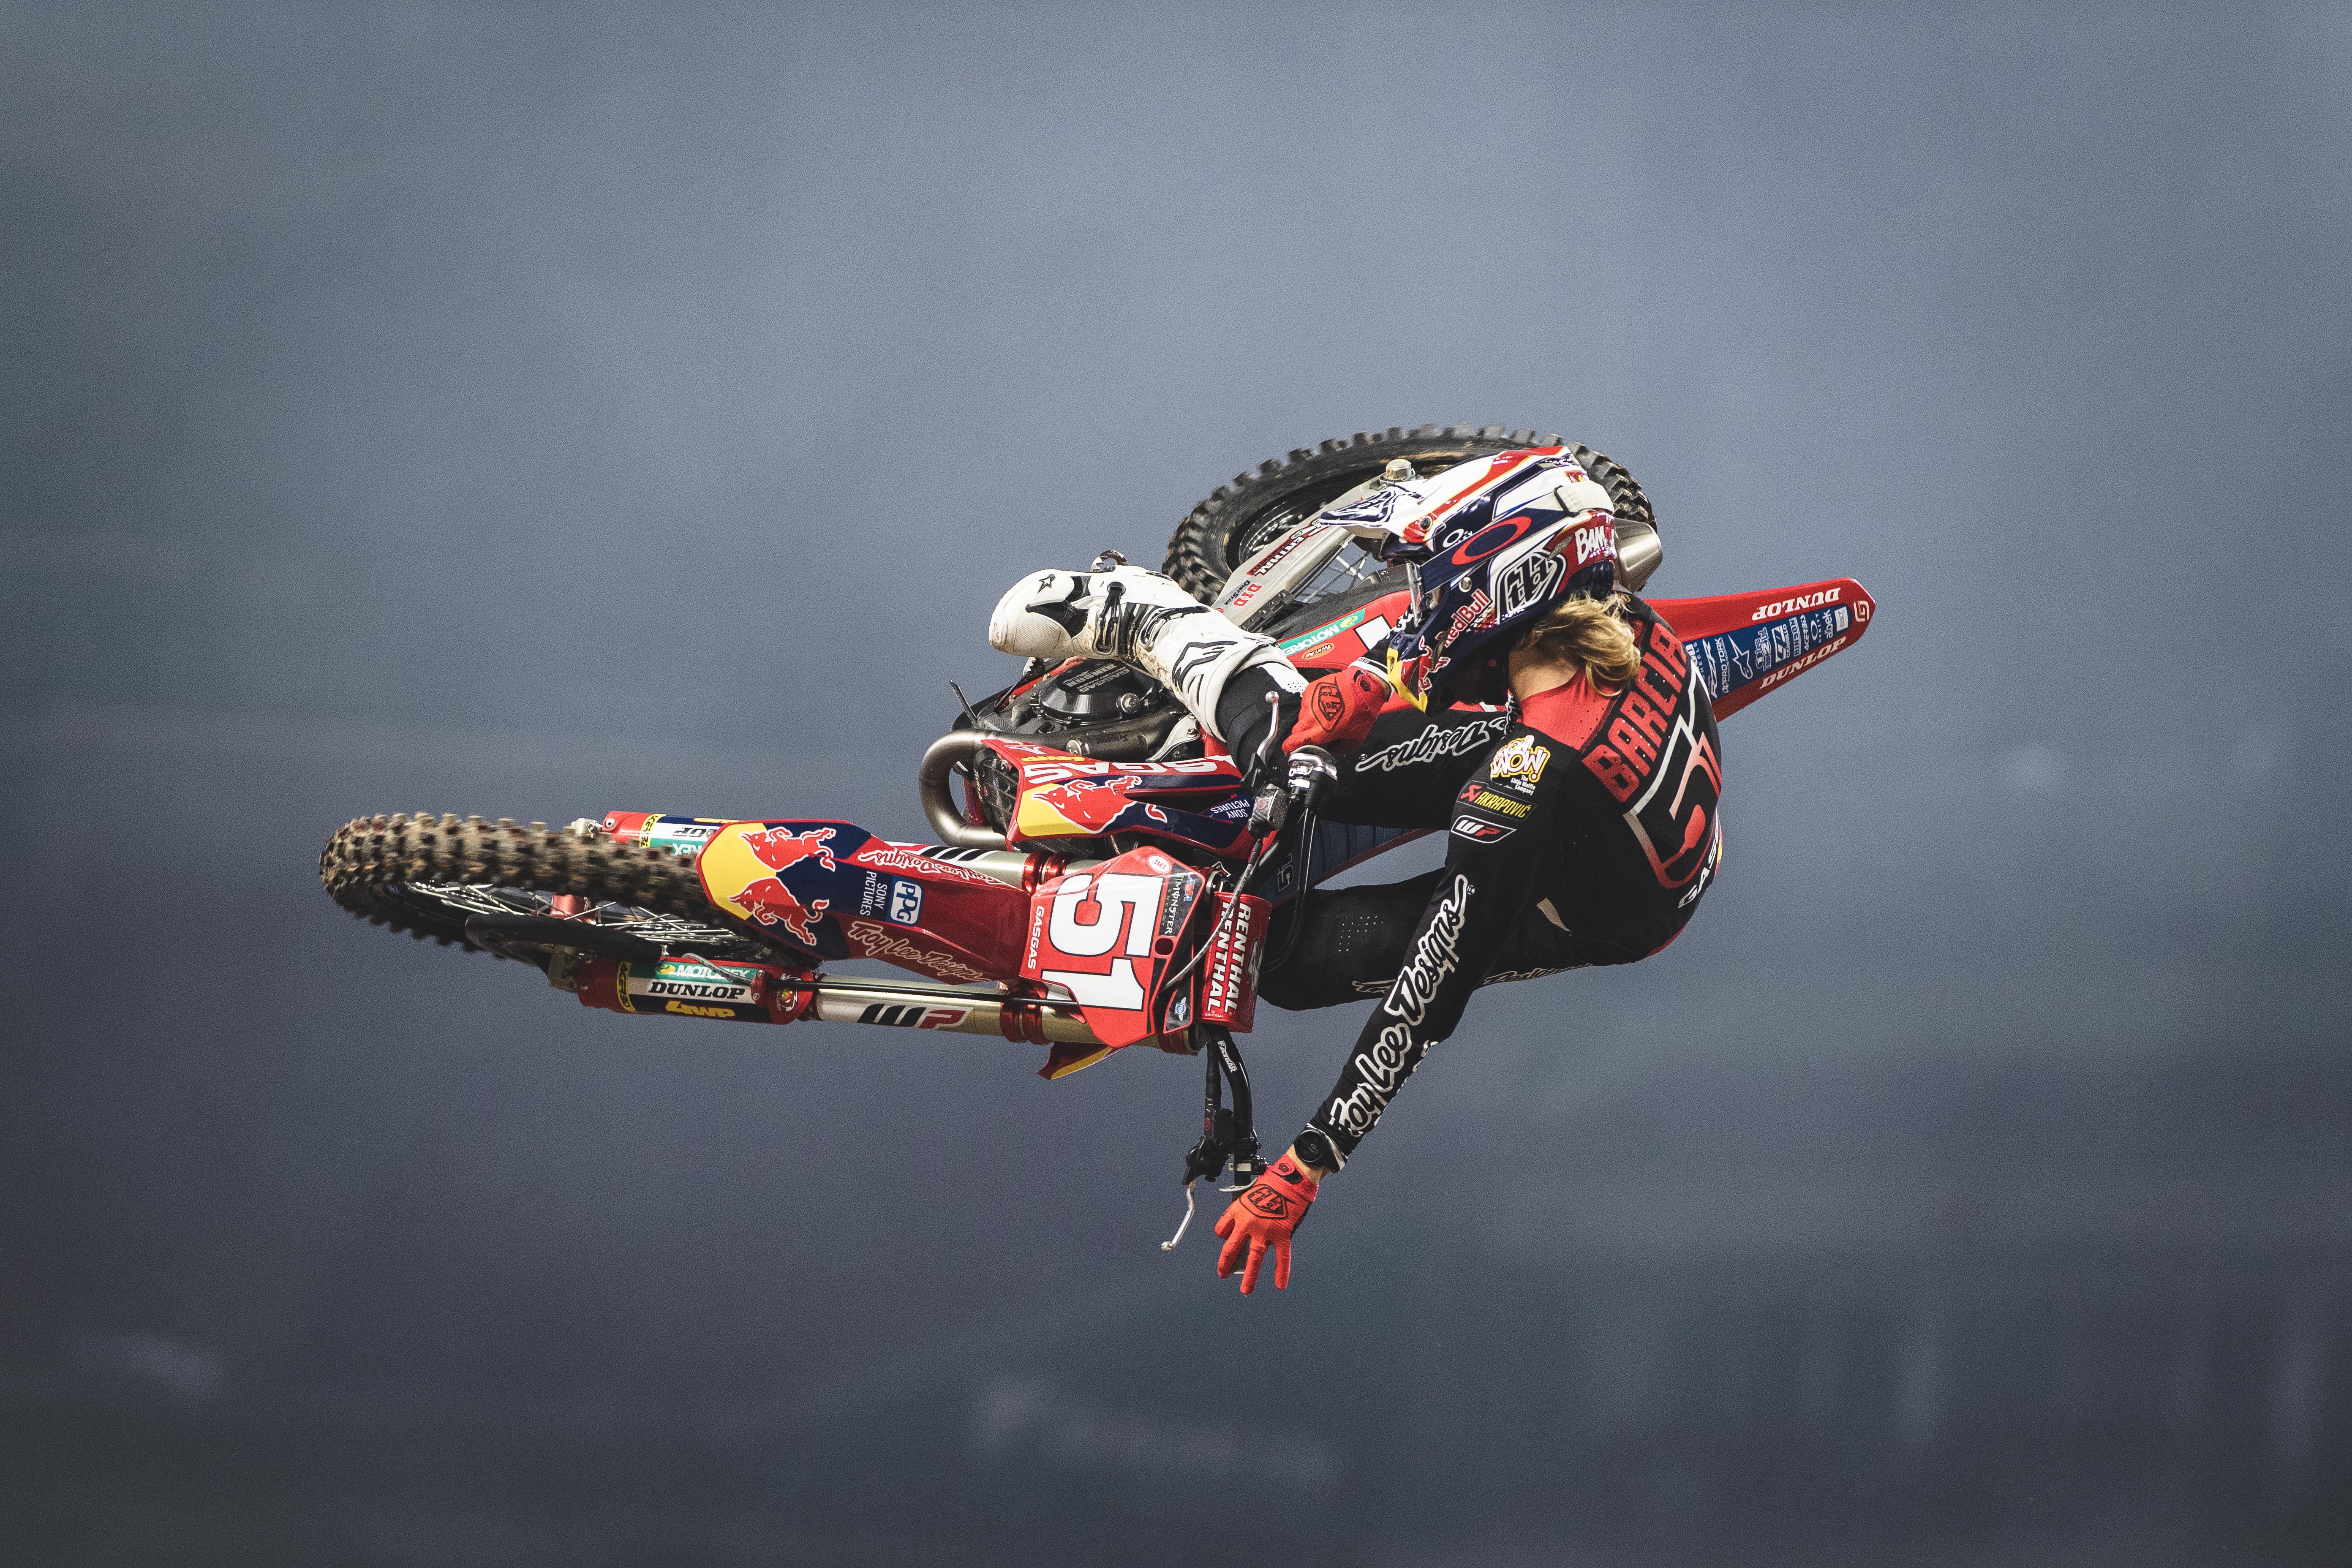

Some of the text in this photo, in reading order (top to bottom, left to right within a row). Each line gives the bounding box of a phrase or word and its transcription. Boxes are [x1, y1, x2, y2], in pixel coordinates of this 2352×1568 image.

[1456, 588, 1491, 623] Bull
[1752, 588, 1840, 621] DUNLOP
[1285, 624, 1340, 654] MOTORE
[1305, 644, 1333, 659] Twin Air
[1715, 637, 1726, 663] TORK
[1782, 623, 1790, 658] CARRILLO
[1790, 617, 1800, 656] HINSON
[1760, 637, 1846, 689] DUNLOP
[1581, 623, 1687, 802] BARCIA
[1511, 777, 1522, 785] Little
[1515, 785, 1534, 796] Company
[1210, 799, 1250, 814] PICTURES
[1226, 808, 1248, 819] SONY
[860, 871, 876, 916] PICTURES
[875, 883, 887, 909] SONY
[1162, 889, 1171, 926] ENERGY
[1165, 881, 1181, 935] MONSTER
[848, 921, 993, 983] Troy Lee Designs
[1028, 906, 1045, 970] GASGAS
[1041, 873, 1164, 1011] 51
[1225, 903, 1251, 1013] RENTHAL
[648, 981, 746, 999] DUNLOP
[1355, 1023, 1412, 1093] Lee
[1384, 874, 1467, 1026] Designs
[857, 1003, 967, 1029] WP
[1217, 1040, 1238, 1073] FATBAR
